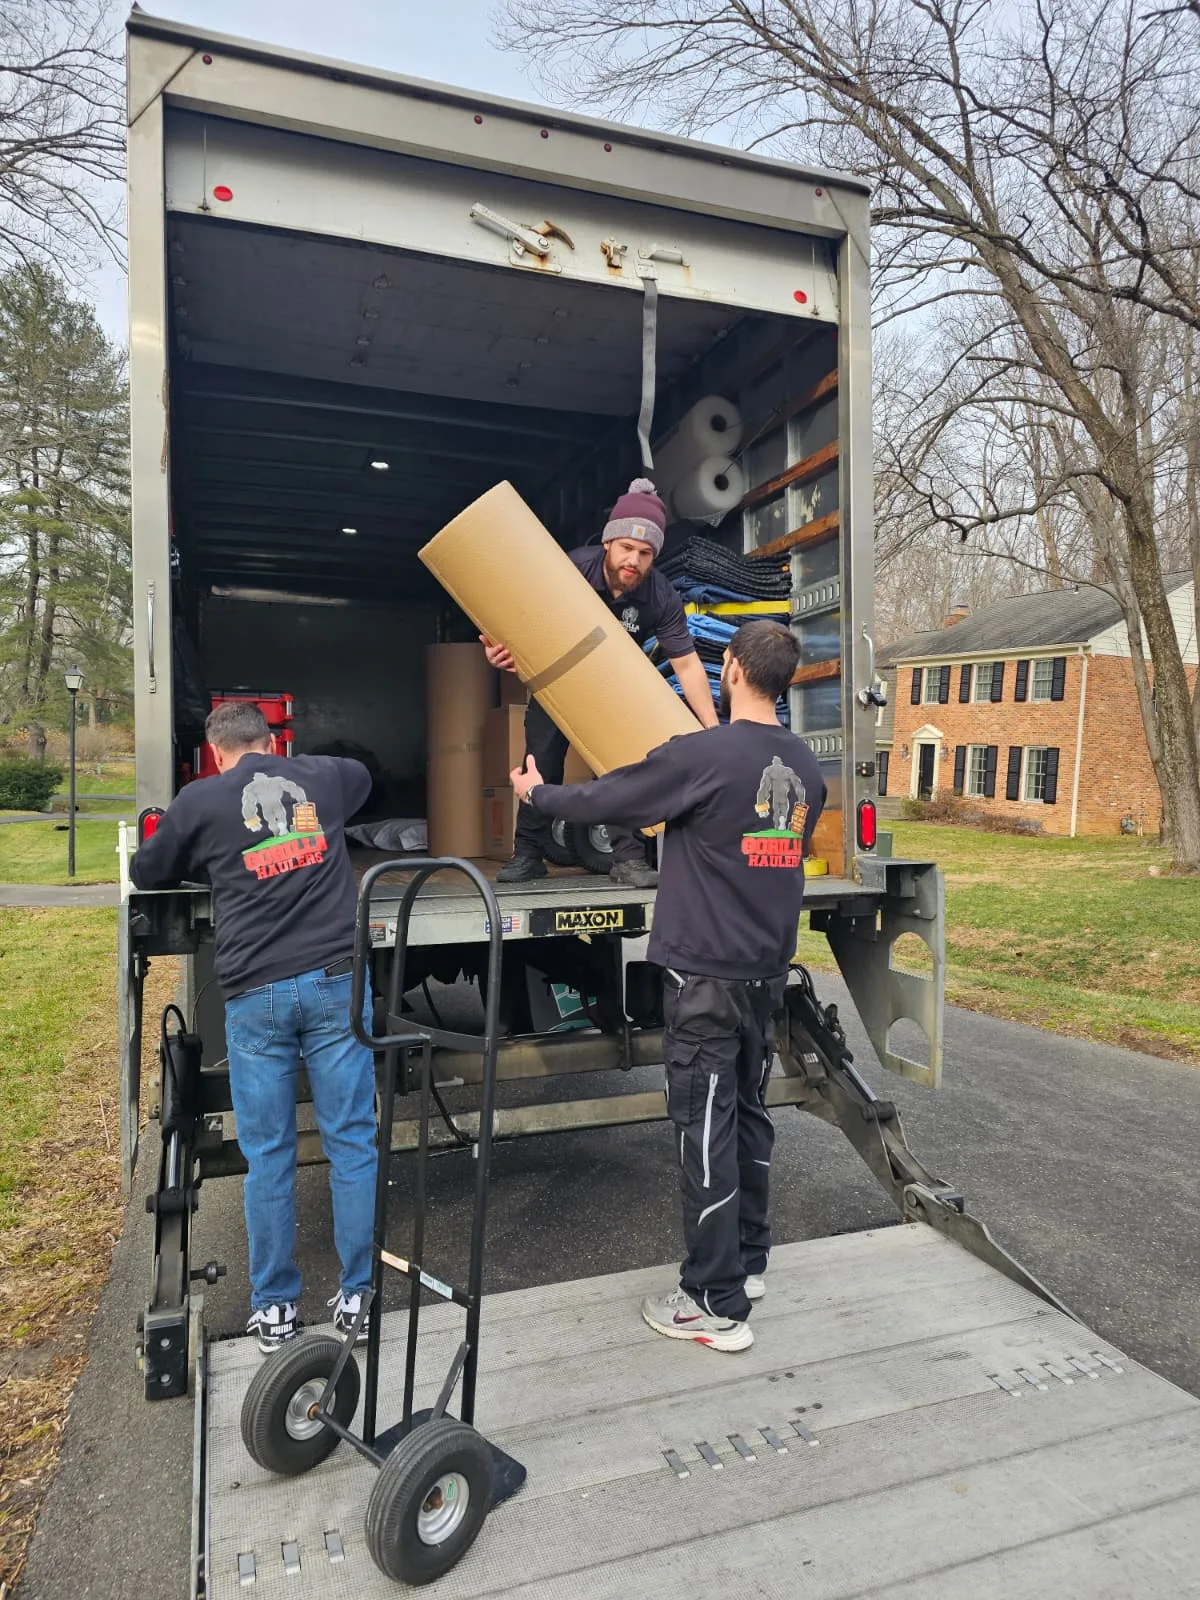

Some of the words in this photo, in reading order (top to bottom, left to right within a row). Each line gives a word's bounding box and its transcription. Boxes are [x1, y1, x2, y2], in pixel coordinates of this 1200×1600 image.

[243, 834, 328, 871] GORILLA
[255, 851, 324, 881] HAULERS
[558, 911, 618, 929] MAXON
[270, 1322, 293, 1336] PUMA
